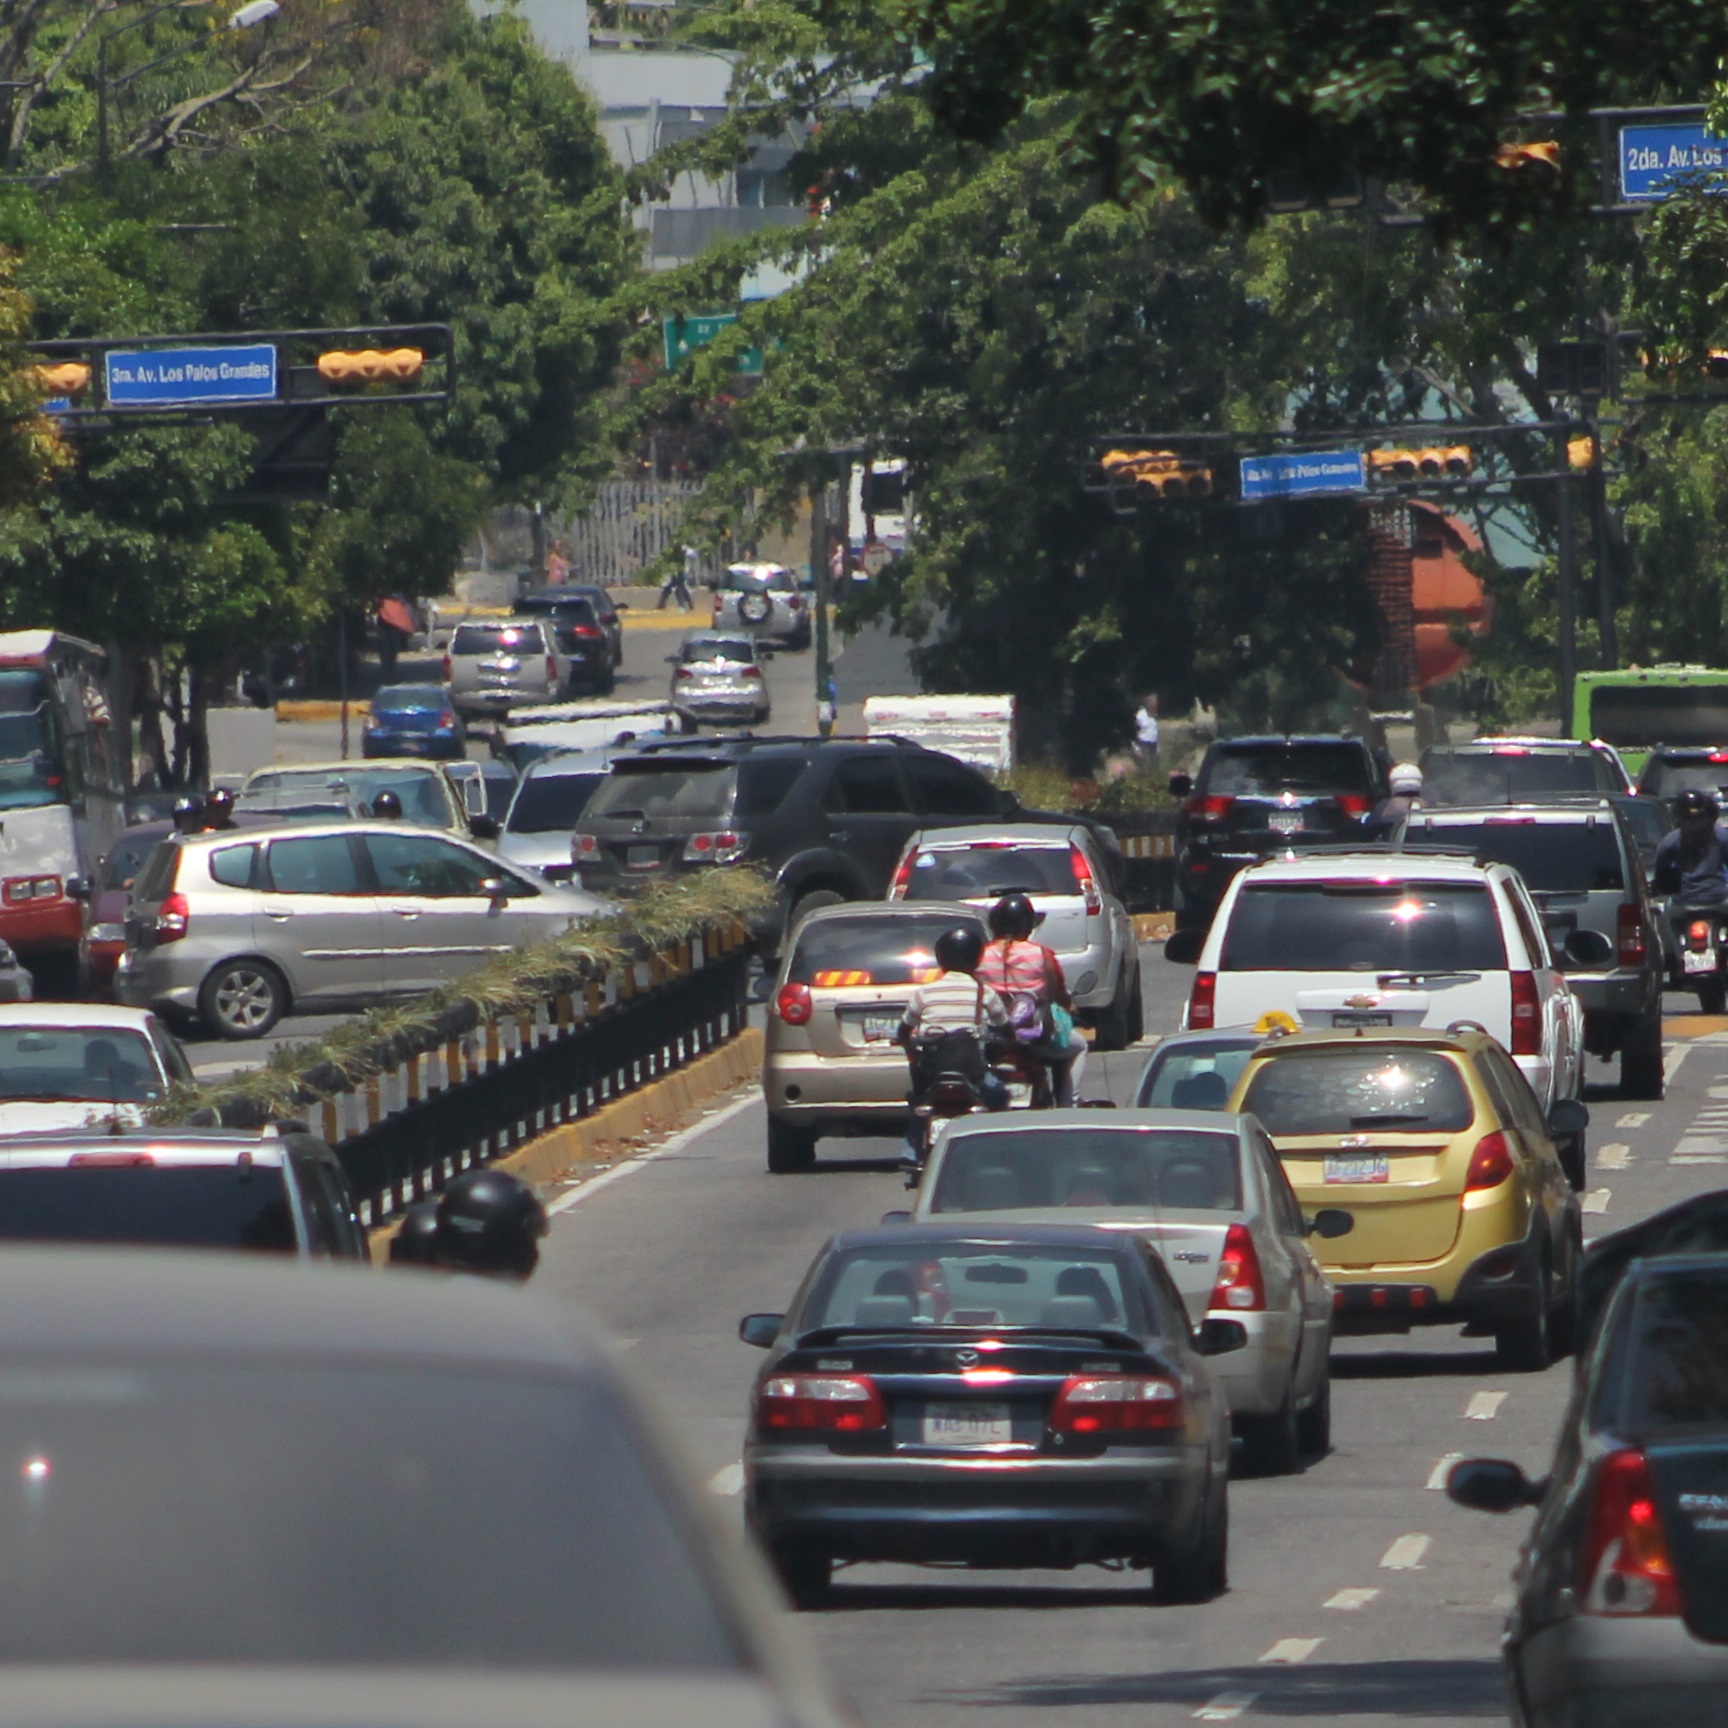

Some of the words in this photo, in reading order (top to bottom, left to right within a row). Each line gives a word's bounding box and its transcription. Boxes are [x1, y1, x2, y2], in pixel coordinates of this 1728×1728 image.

[1628, 147, 1664, 171] 2da.
[1667, 145, 1690, 168] Av.
[1692, 144, 1722, 167] Los
[137, 366, 157, 383] Av.
[159, 365, 183, 383] Los
[186, 364, 218, 382] Palos
[220, 362, 270, 380] Grandes
